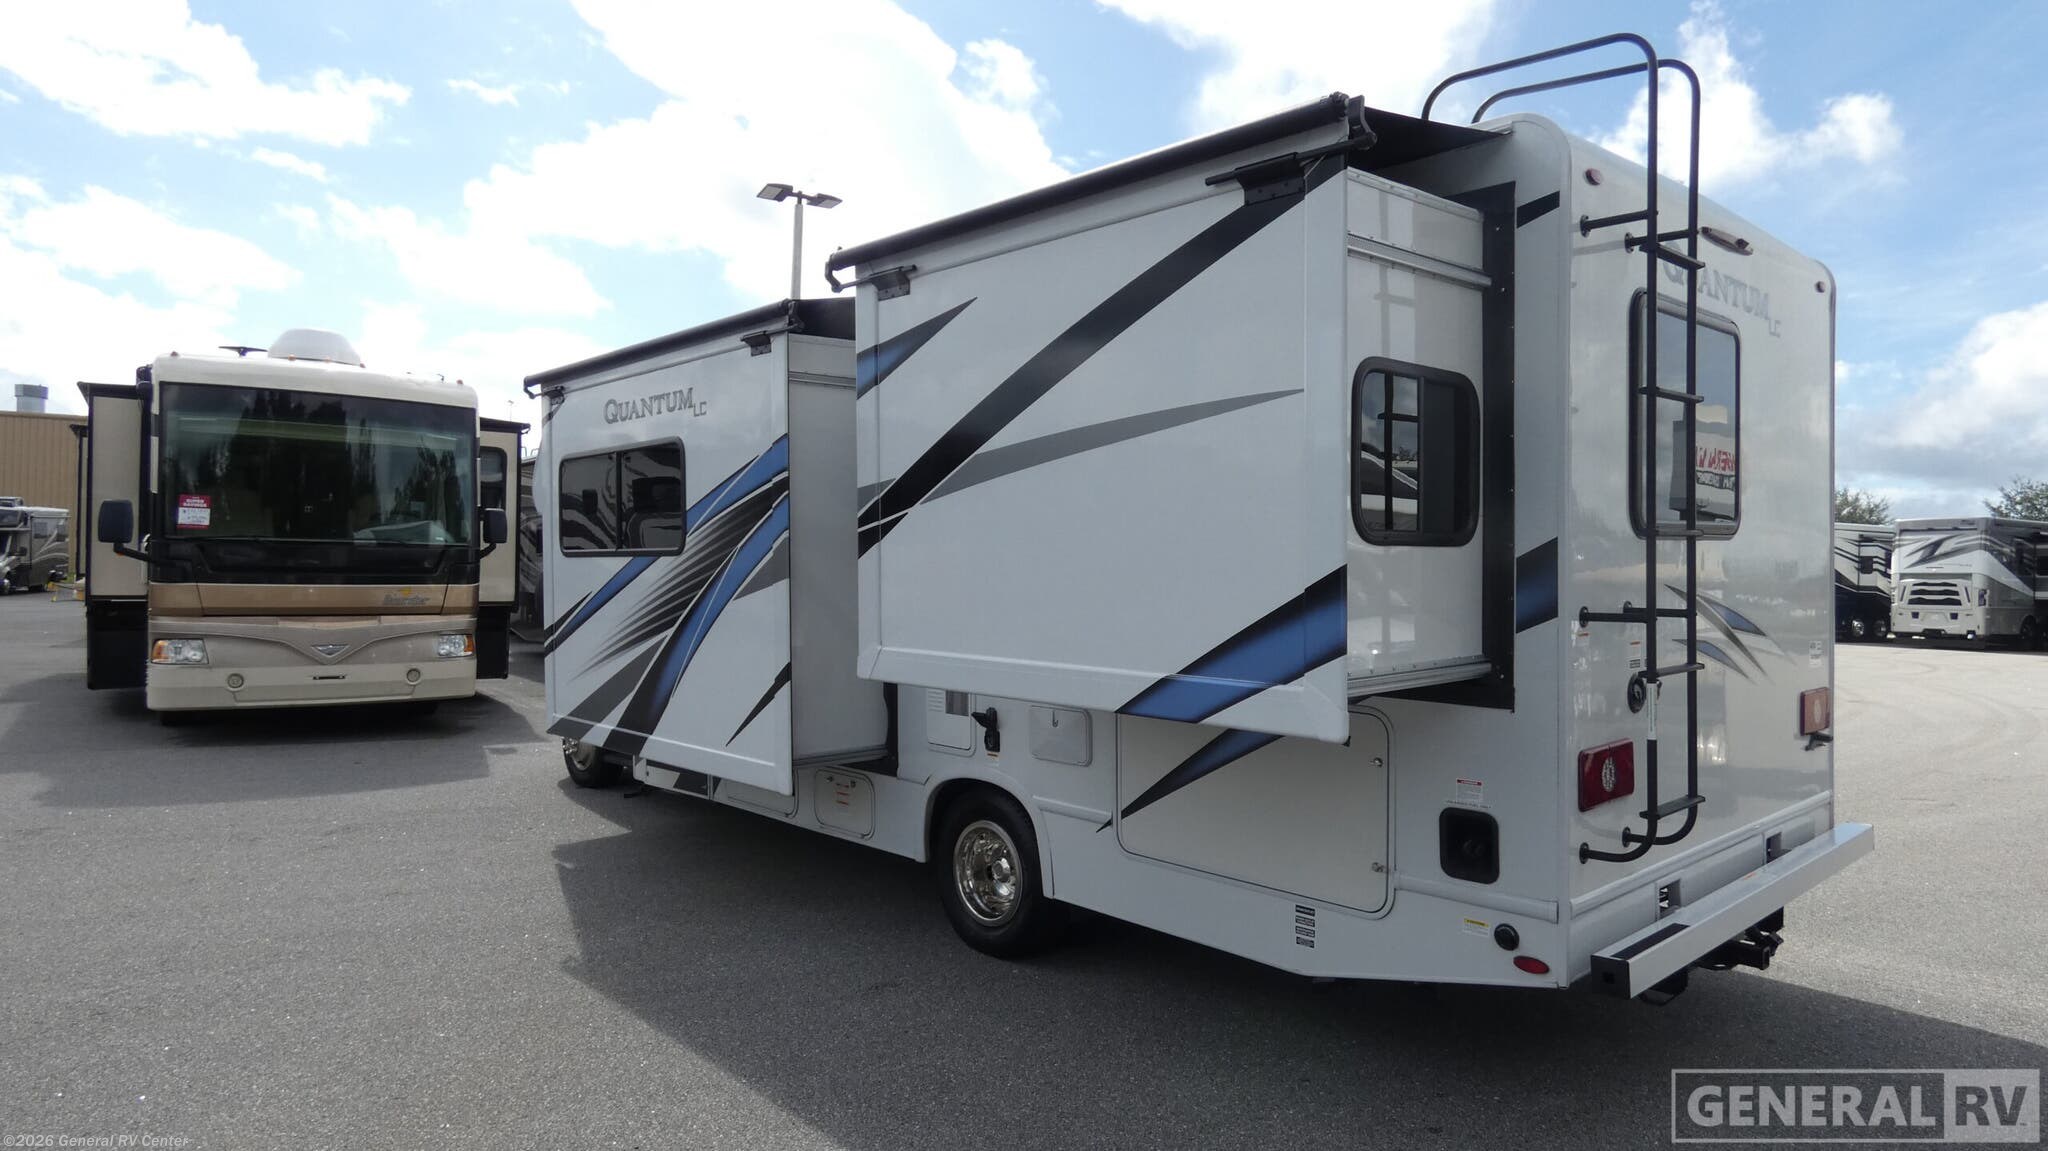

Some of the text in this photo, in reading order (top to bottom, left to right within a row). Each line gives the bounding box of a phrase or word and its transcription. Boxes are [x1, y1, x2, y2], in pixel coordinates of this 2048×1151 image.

[1663, 242, 1770, 321] QANTUM
[604, 387, 707, 424] QUANTUM LC
